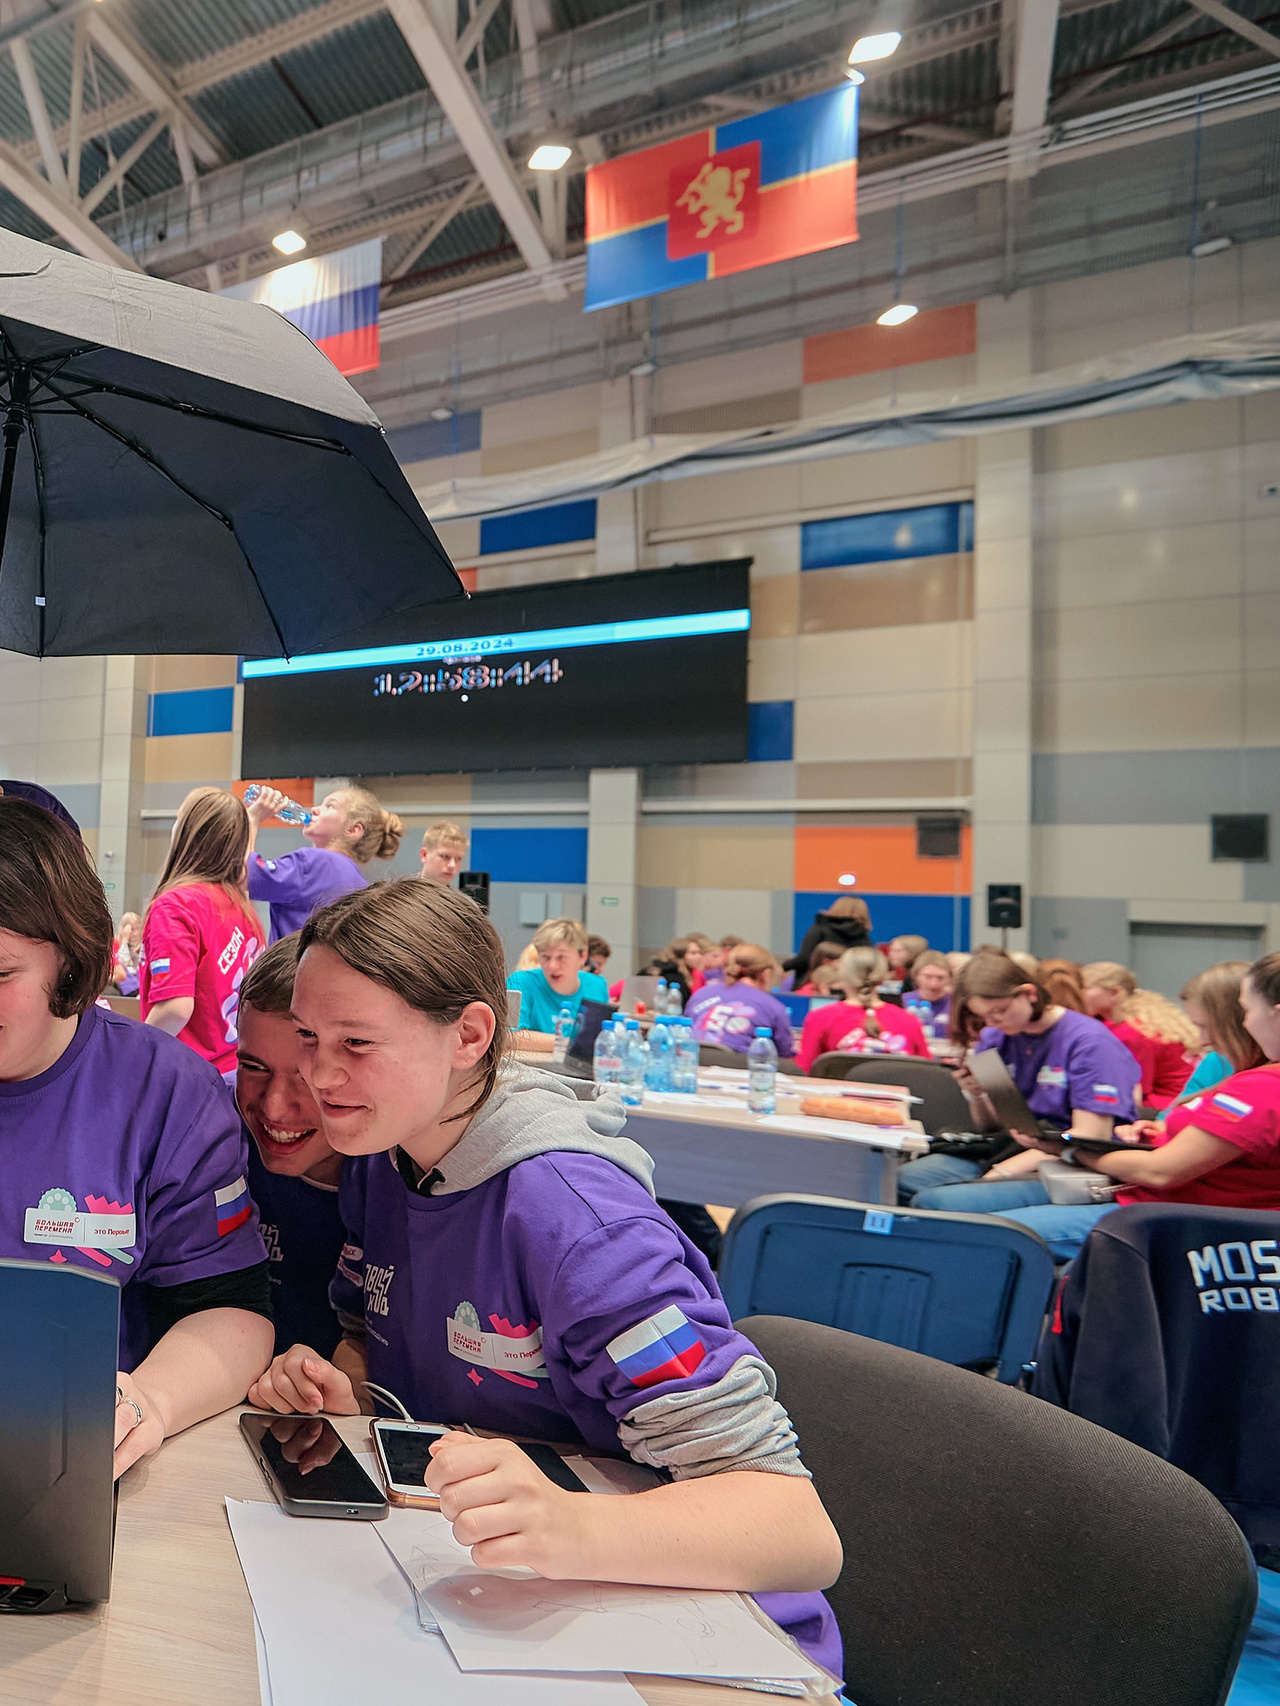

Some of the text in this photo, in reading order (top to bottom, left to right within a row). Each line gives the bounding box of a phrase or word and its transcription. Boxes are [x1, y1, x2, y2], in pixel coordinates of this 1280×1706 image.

[416, 637, 514, 657] 29.08.2024
[217, 925, 245, 975] СЕЗОН
[34, 1225, 73, 1234] ПЕРЕМЕНА
[35, 1219, 75, 1228] БОЛЬШАЯ
[1186, 1240, 1280, 1288] MOS
[1198, 1286, 1280, 1314] ROB
